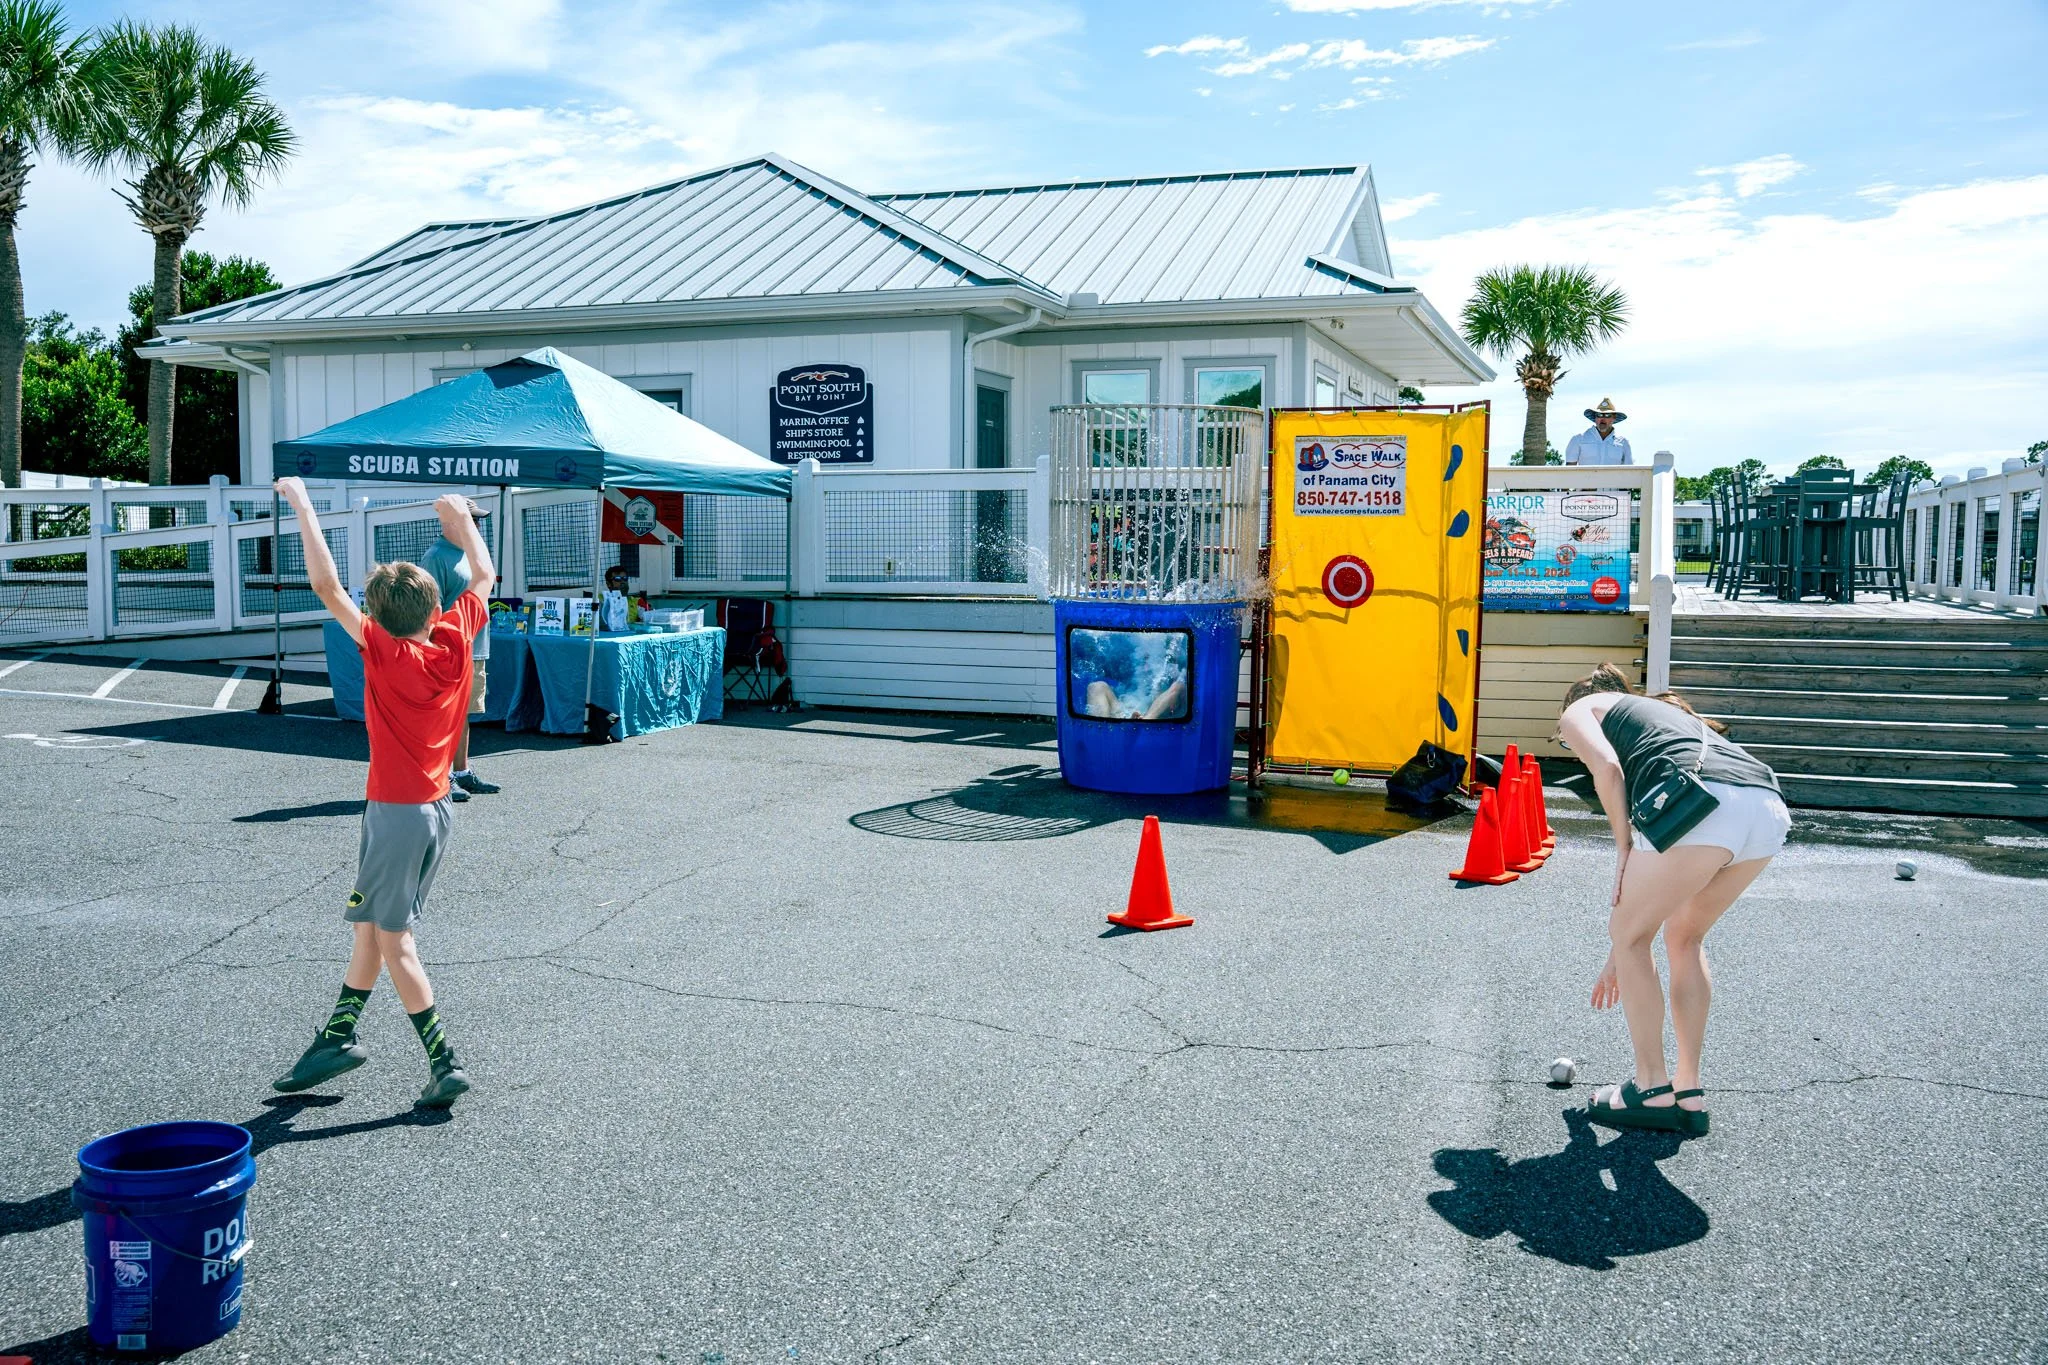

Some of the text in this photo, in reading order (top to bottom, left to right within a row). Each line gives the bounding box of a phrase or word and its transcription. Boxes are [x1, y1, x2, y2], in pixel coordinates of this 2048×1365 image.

[780, 383, 861, 395] POINT SOUTH
[779, 416, 850, 426] MARINA OFFICE
[785, 428, 844, 438] SHIP'S STORE
[776, 439, 852, 449] SWIMMING POOL
[787, 450, 841, 460] RESTROOMS
[1334, 449, 1401, 462] SPACE WALK
[348, 455, 519, 477] SCUBA STATION
[1303, 474, 1396, 488] of Panama City
[1297, 490, 1402, 506] 850-747-1518
[1300, 507, 1400, 515] www.herecomesfun.com
[1501, 548, 1506, 557] &
[1507, 548, 1534, 560] SPEARS
[543, 600, 557, 610] TRY
[204, 1218, 240, 1256] DO
